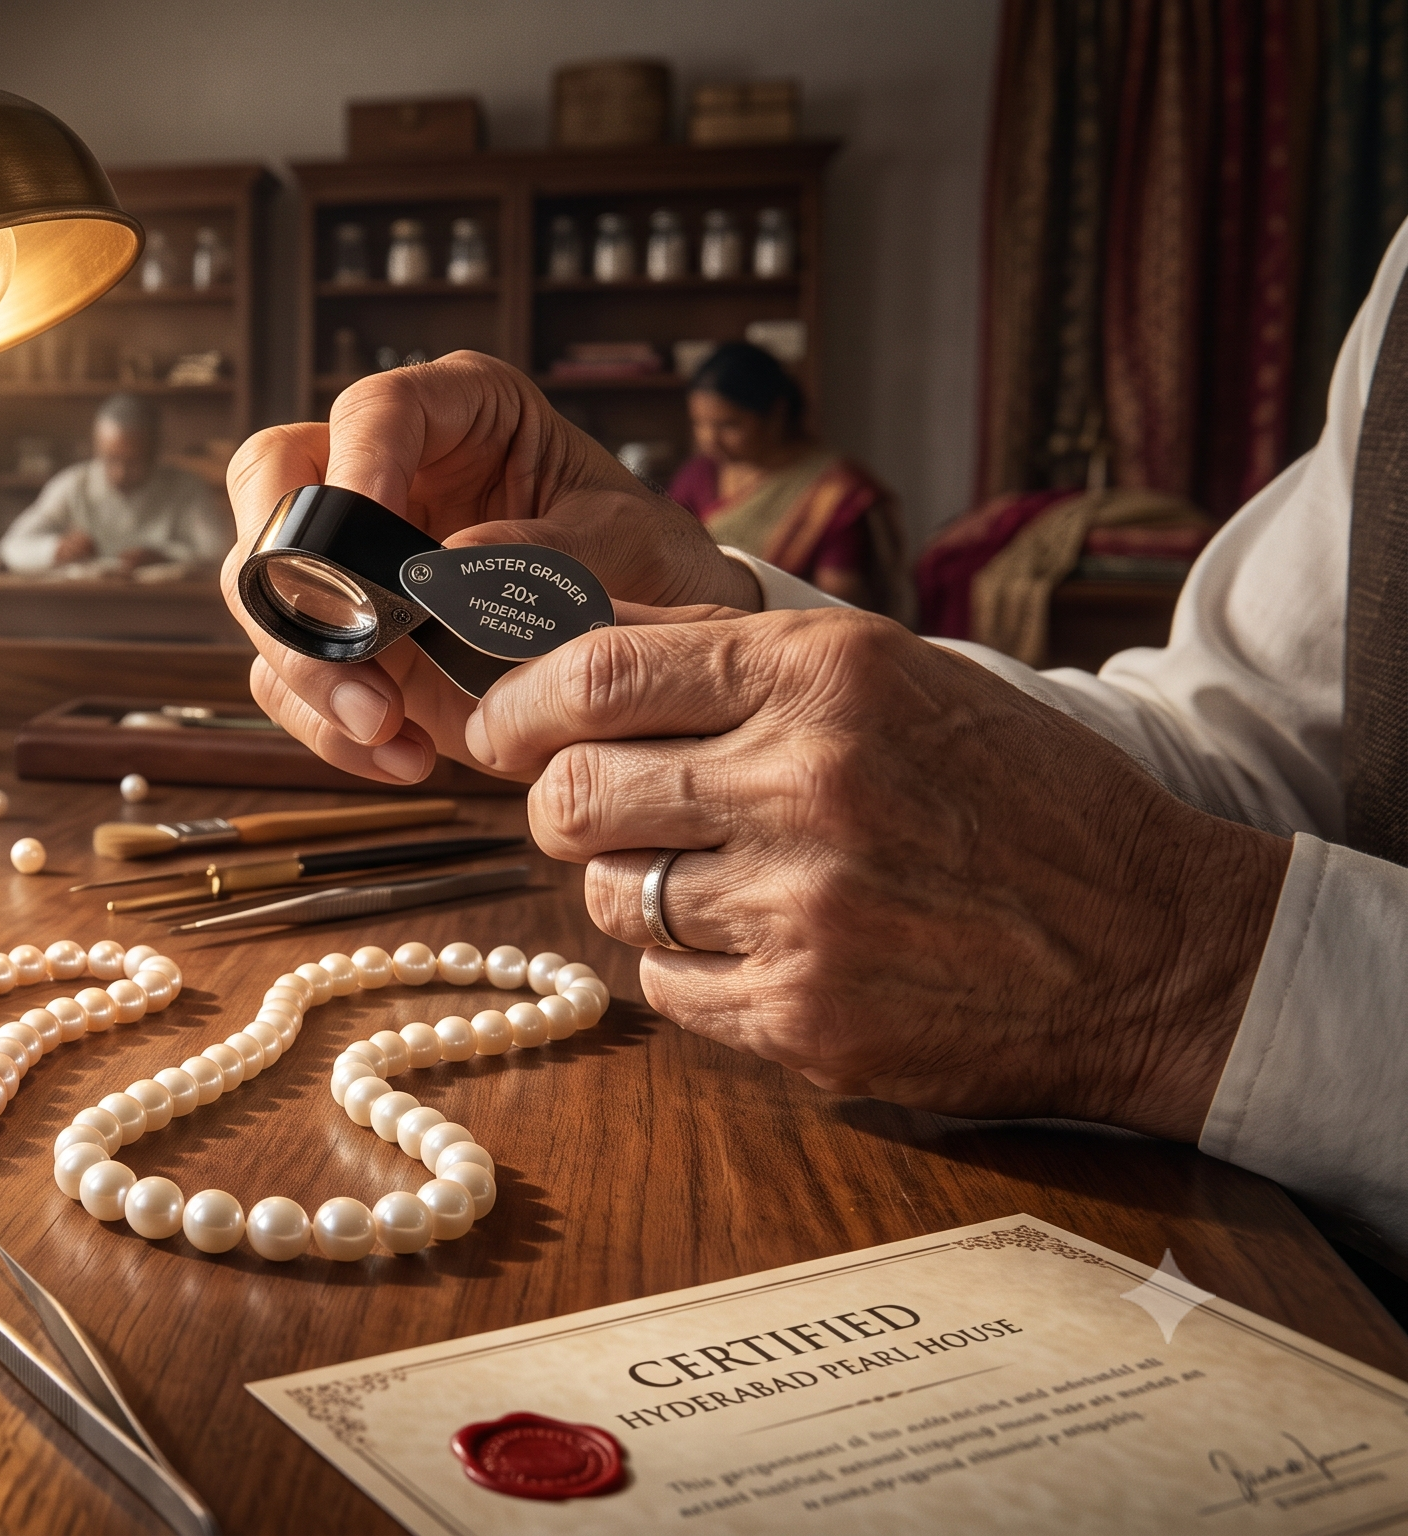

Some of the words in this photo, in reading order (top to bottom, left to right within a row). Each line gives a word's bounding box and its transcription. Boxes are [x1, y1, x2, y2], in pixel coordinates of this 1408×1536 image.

[460, 558, 526, 576] MASTER
[529, 563, 588, 606] GRADER
[468, 596, 557, 632] HYDERABAD
[479, 615, 535, 642] PEARLS
[627, 1304, 921, 1389] CERTIFIED
[615, 1370, 820, 1430] HYDERABAD
[817, 1346, 920, 1380] PEARL
[912, 1318, 1024, 1356] HOUSE
